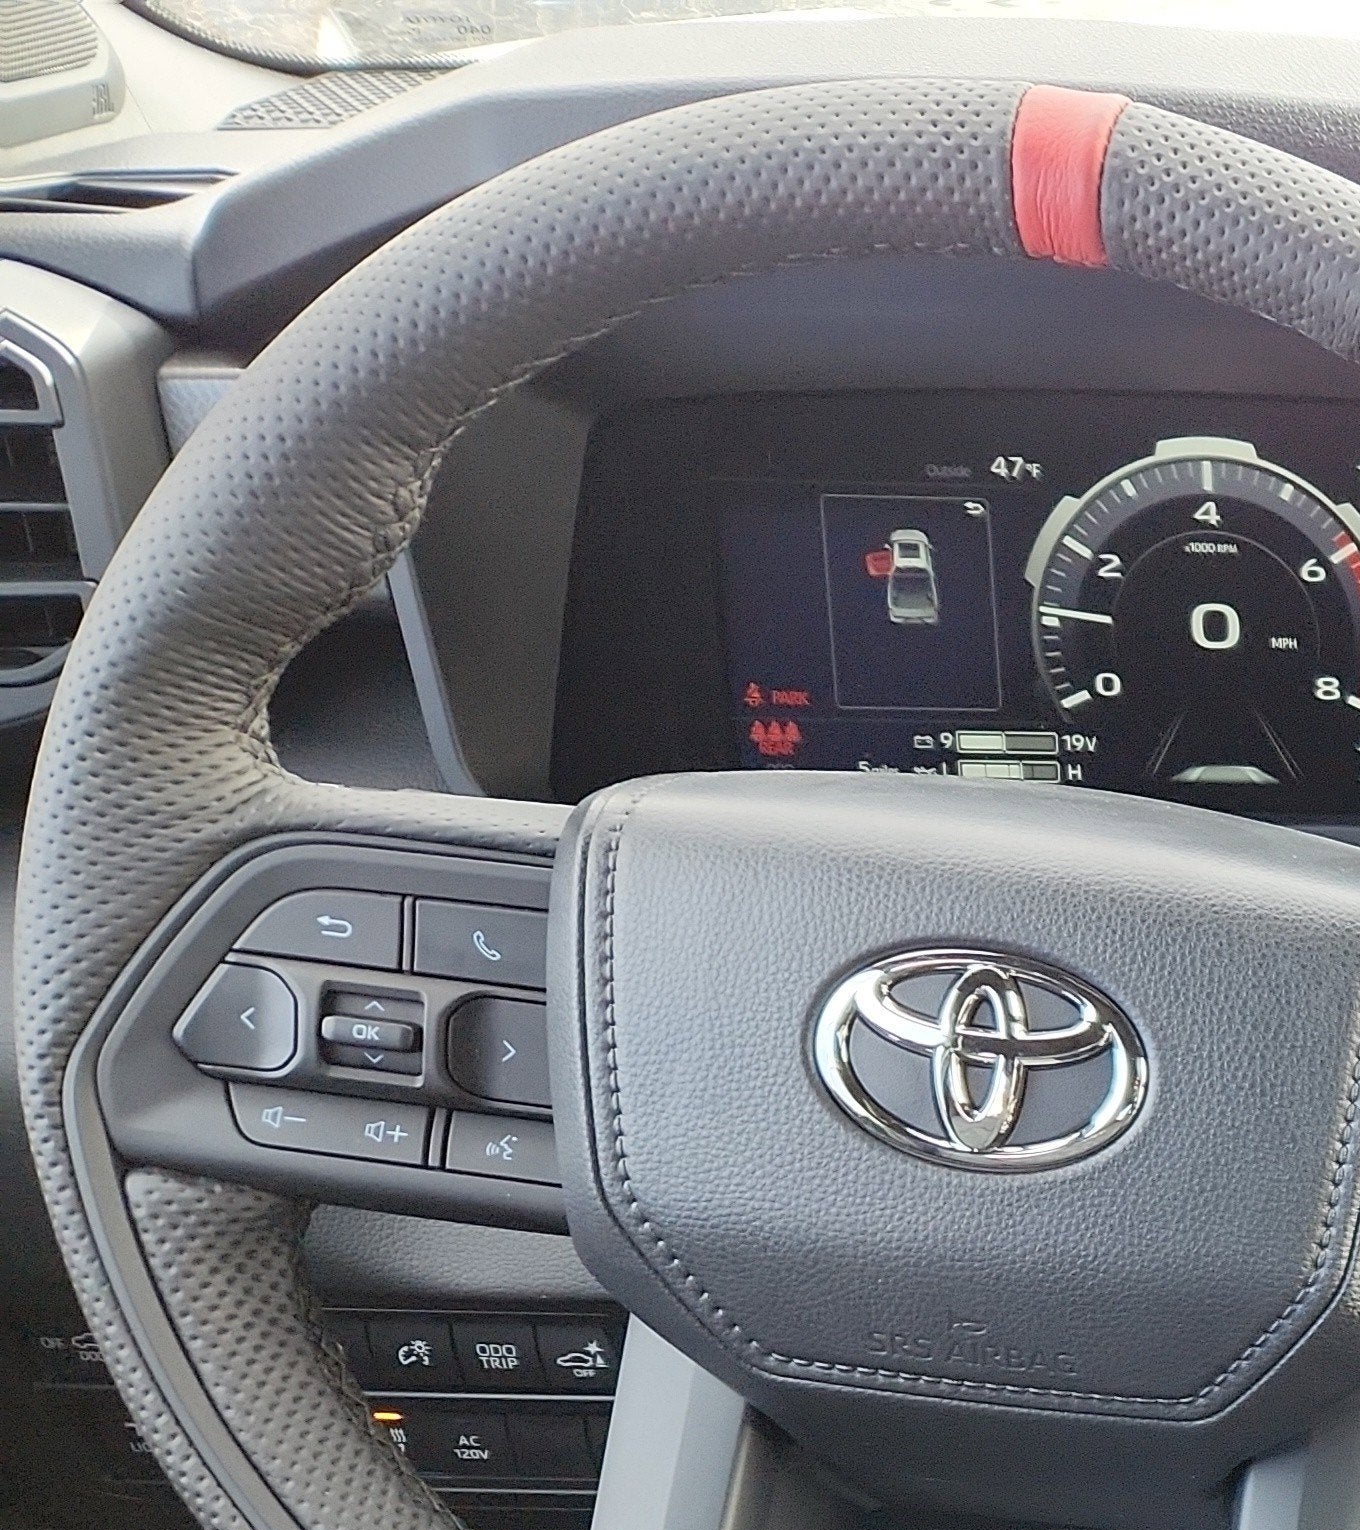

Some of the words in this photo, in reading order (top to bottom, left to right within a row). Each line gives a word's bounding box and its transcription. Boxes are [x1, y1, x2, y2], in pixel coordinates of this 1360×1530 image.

[1192, 501, 1221, 526] 4
[1097, 553, 1123, 578] 2
[1299, 557, 1327, 583] 6
[1189, 602, 1241, 650] 0
[1270, 636, 1299, 650] MPH
[1094, 672, 1122, 697] 0
[1313, 676, 1342, 701] 8
[939, 731, 954, 749] 9
[1060, 734, 1098, 753] 19V
[1067, 764, 1083, 781] H
[351, 1024, 380, 1042] OK
[475, 1343, 517, 1357] ODO
[478, 1357, 520, 1370] TRIP
[572, 1368, 597, 1378] OFF
[457, 1434, 482, 1447] AC
[452, 1448, 490, 1461] 120V
